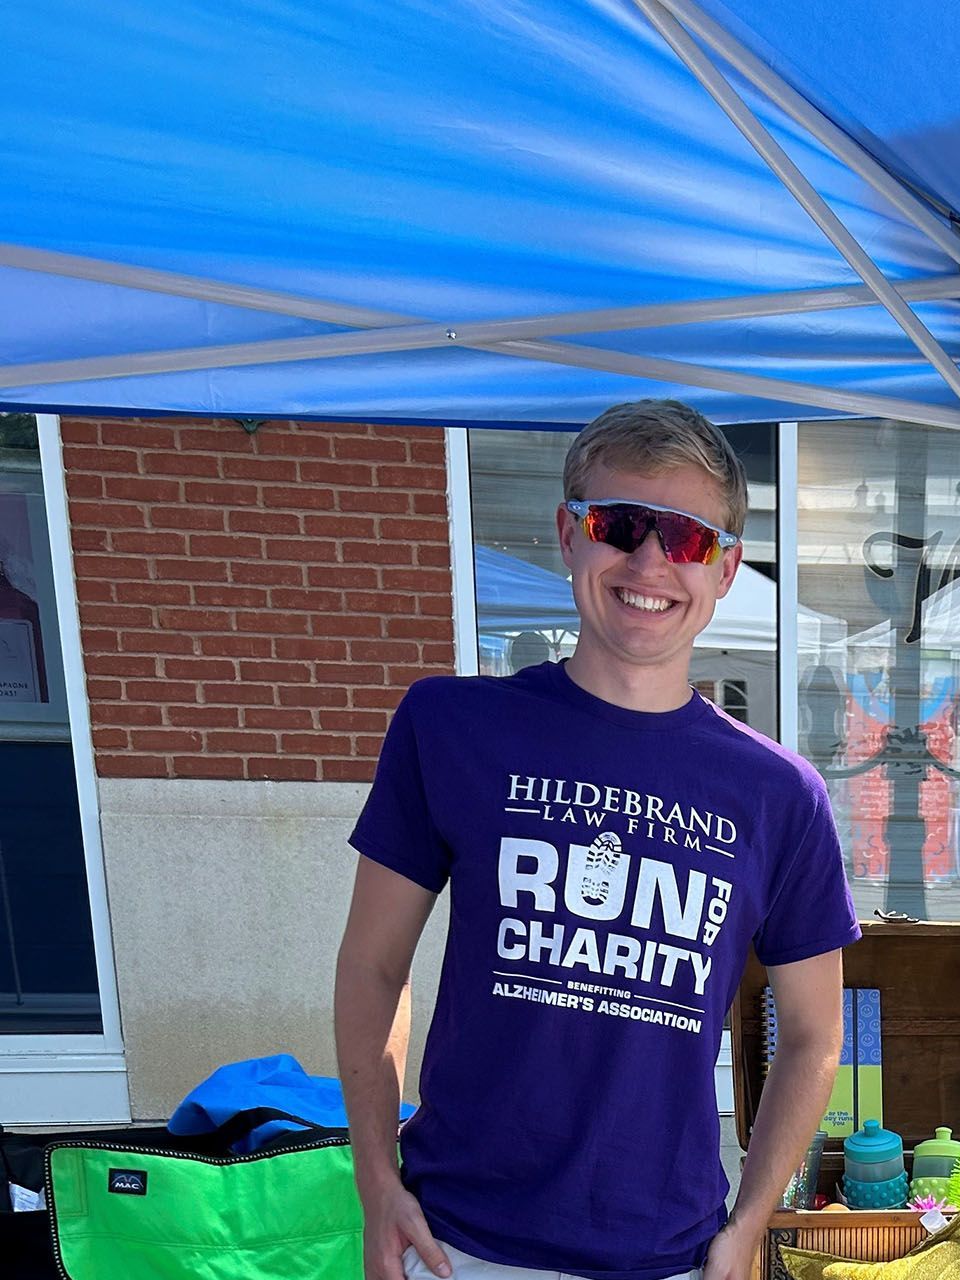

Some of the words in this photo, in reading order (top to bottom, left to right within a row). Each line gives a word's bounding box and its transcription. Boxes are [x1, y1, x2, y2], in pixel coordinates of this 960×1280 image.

[507, 774, 737, 845] HILDEBRAND
[543, 804, 607, 827] LAW
[627, 819, 702, 852] FIRM
[498, 836, 707, 941] RUN
[703, 876, 734, 947] FOR
[497, 917, 712, 996] CHARITY
[492, 982, 595, 1012] ALZHEIMER'S
[597, 1000, 702, 1034] ASSOCIATION
[567, 981, 632, 999] BENEFITTING
[115, 1182, 140, 1190] MAC
